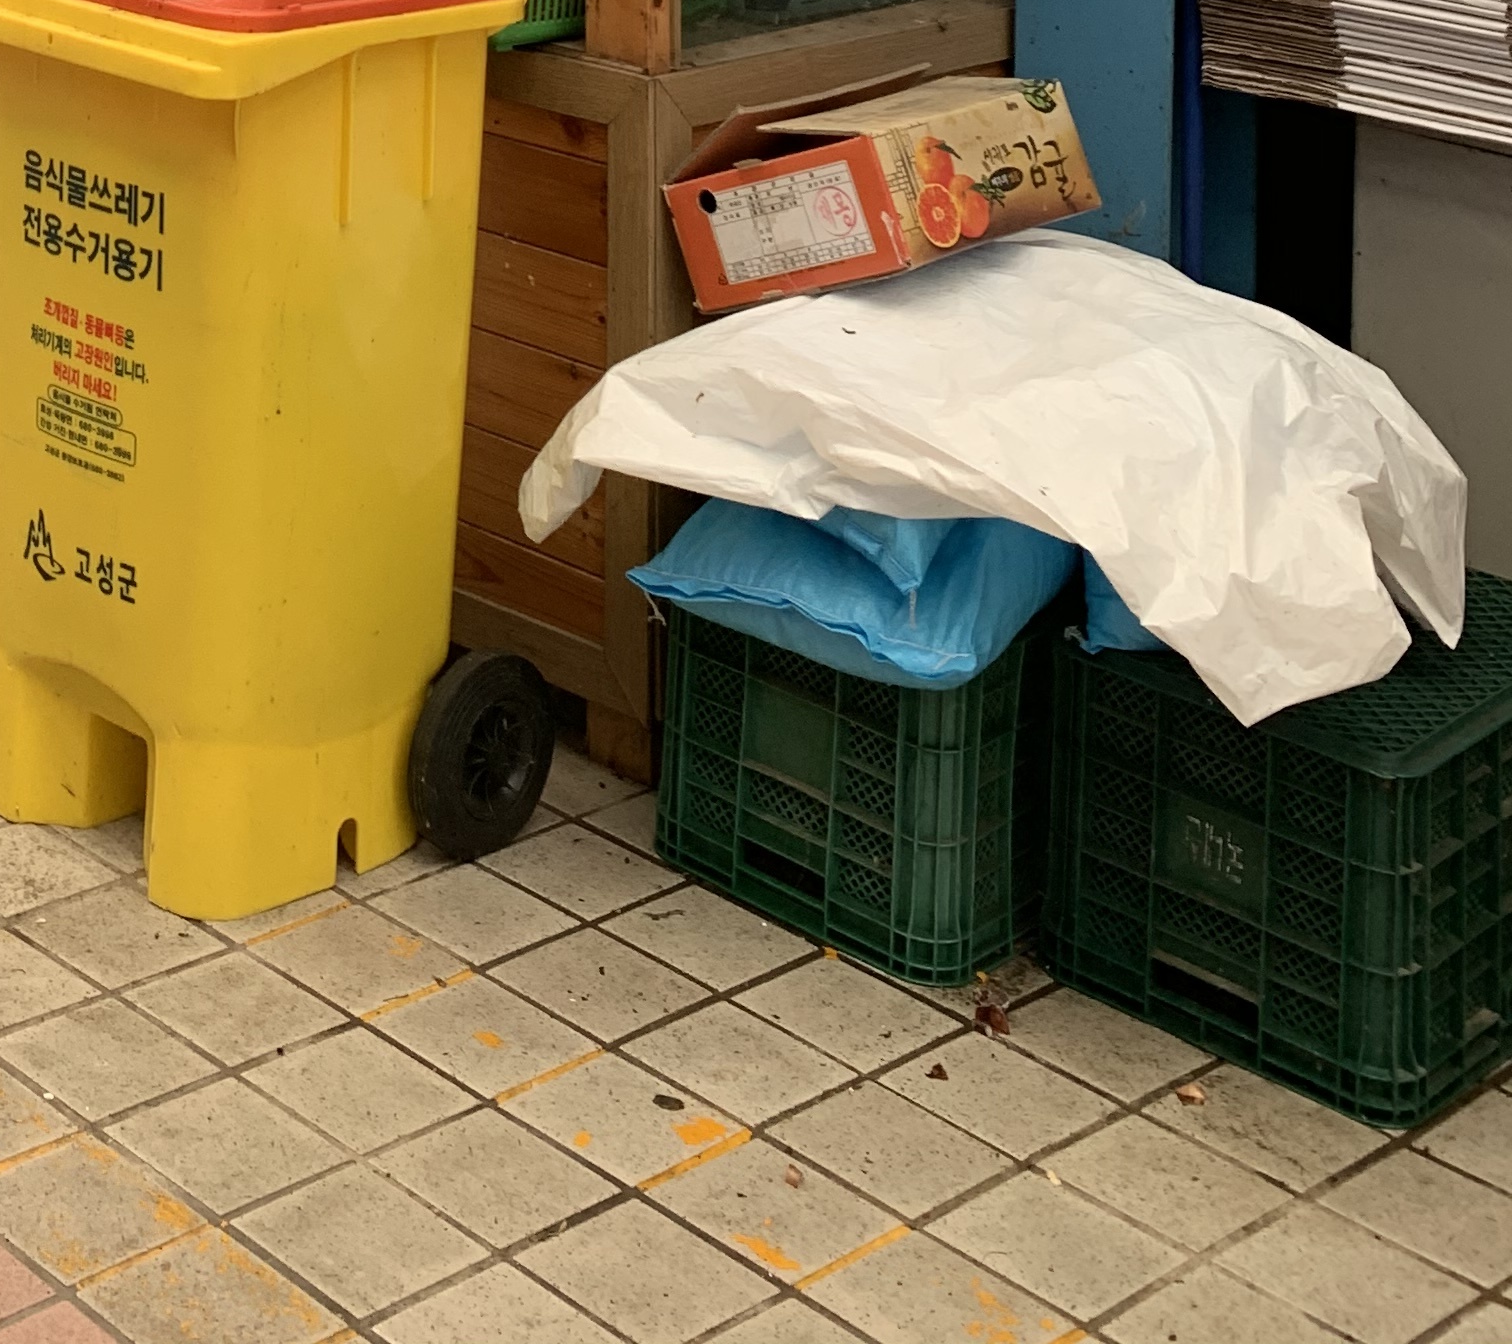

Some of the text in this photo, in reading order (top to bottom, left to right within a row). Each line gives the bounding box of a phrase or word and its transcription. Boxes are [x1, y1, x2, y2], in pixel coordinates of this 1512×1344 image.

[22, 148, 166, 236] 음식물쓰레기
[1012, 134, 1078, 202] 감귤
[21, 203, 164, 293] 전용수거용기
[52, 360, 118, 403] 버리지 마세요!
[74, 546, 139, 605] 고성군
